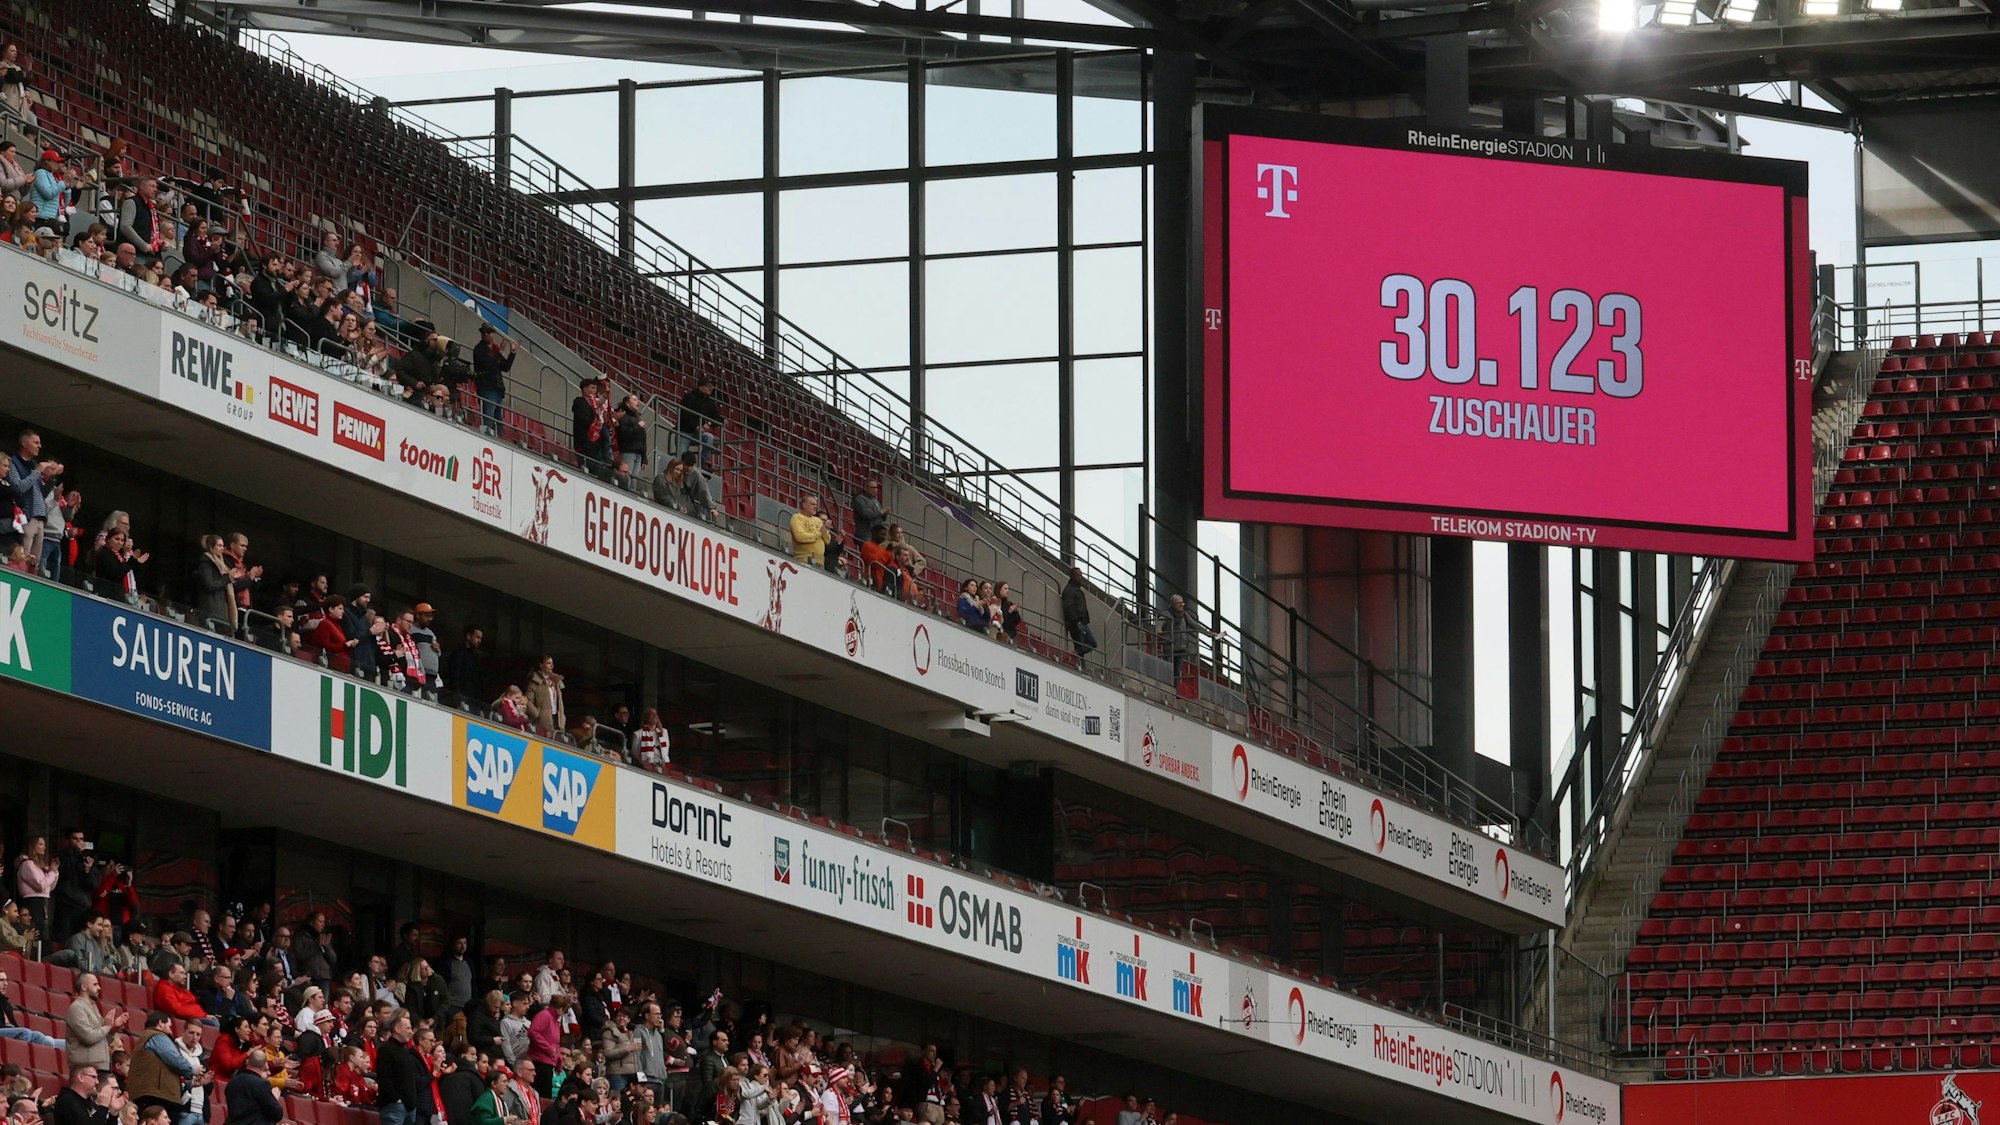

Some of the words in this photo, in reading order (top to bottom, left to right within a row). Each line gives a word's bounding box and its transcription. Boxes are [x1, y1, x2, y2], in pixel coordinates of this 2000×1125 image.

[1408, 130, 1573, 160] RheinEnergieSTADION
[1257, 163, 1298, 219] T
[24, 281, 98, 343] seitz
[1380, 273, 1644, 399] 30.123
[172, 331, 232, 396] REWE
[227, 403, 254, 421] GROUP
[271, 382, 316, 429] REWE
[1428, 395, 1597, 446] ZUSCHAUER
[400, 436, 446, 477] toom
[472, 456, 501, 500] DER
[472, 496, 501, 520] Touristik
[1431, 516, 1501, 537] TELEKOM
[1505, 521, 1596, 543] STADION-TV
[0, 581, 32, 672] K
[112, 615, 235, 701] SAUREN
[938, 649, 970, 677] Flossbach
[970, 664, 984, 683] von
[984, 667, 1006, 690] Storch
[1017, 671, 1038, 699] UTH
[135, 691, 199, 723] FONDS-SERVICE
[201, 710, 212, 726] AG
[1045, 702, 1060, 719] darin
[320, 675, 407, 788] HDI
[466, 738, 514, 800] SAP
[1251, 768, 1301, 808] RheinEnergie
[543, 761, 588, 822] SAP
[1322, 781, 1346, 812] Rhein
[652, 782, 732, 848] Dorint
[1319, 801, 1352, 838] Energie
[651, 836, 682, 868] Hotels
[685, 847, 692, 871] &
[696, 849, 732, 882] Resorts
[1388, 821, 1433, 859] RheinEnergie
[1452, 832, 1474, 862] Rhein
[802, 839, 894, 910] funny-frisch
[1449, 851, 1478, 887] Energie
[1511, 870, 1551, 905] RheinEnergie
[939, 885, 1022, 954] OSMAB
[1058, 943, 1089, 985] mk
[1116, 960, 1147, 1001] mk
[1173, 978, 1202, 1017] mk
[1307, 1010, 1357, 1048] RheinEnergie
[1374, 1023, 1503, 1097] RheinEnergieSTADION
[1565, 1091, 1606, 1124] RheinEnergie
